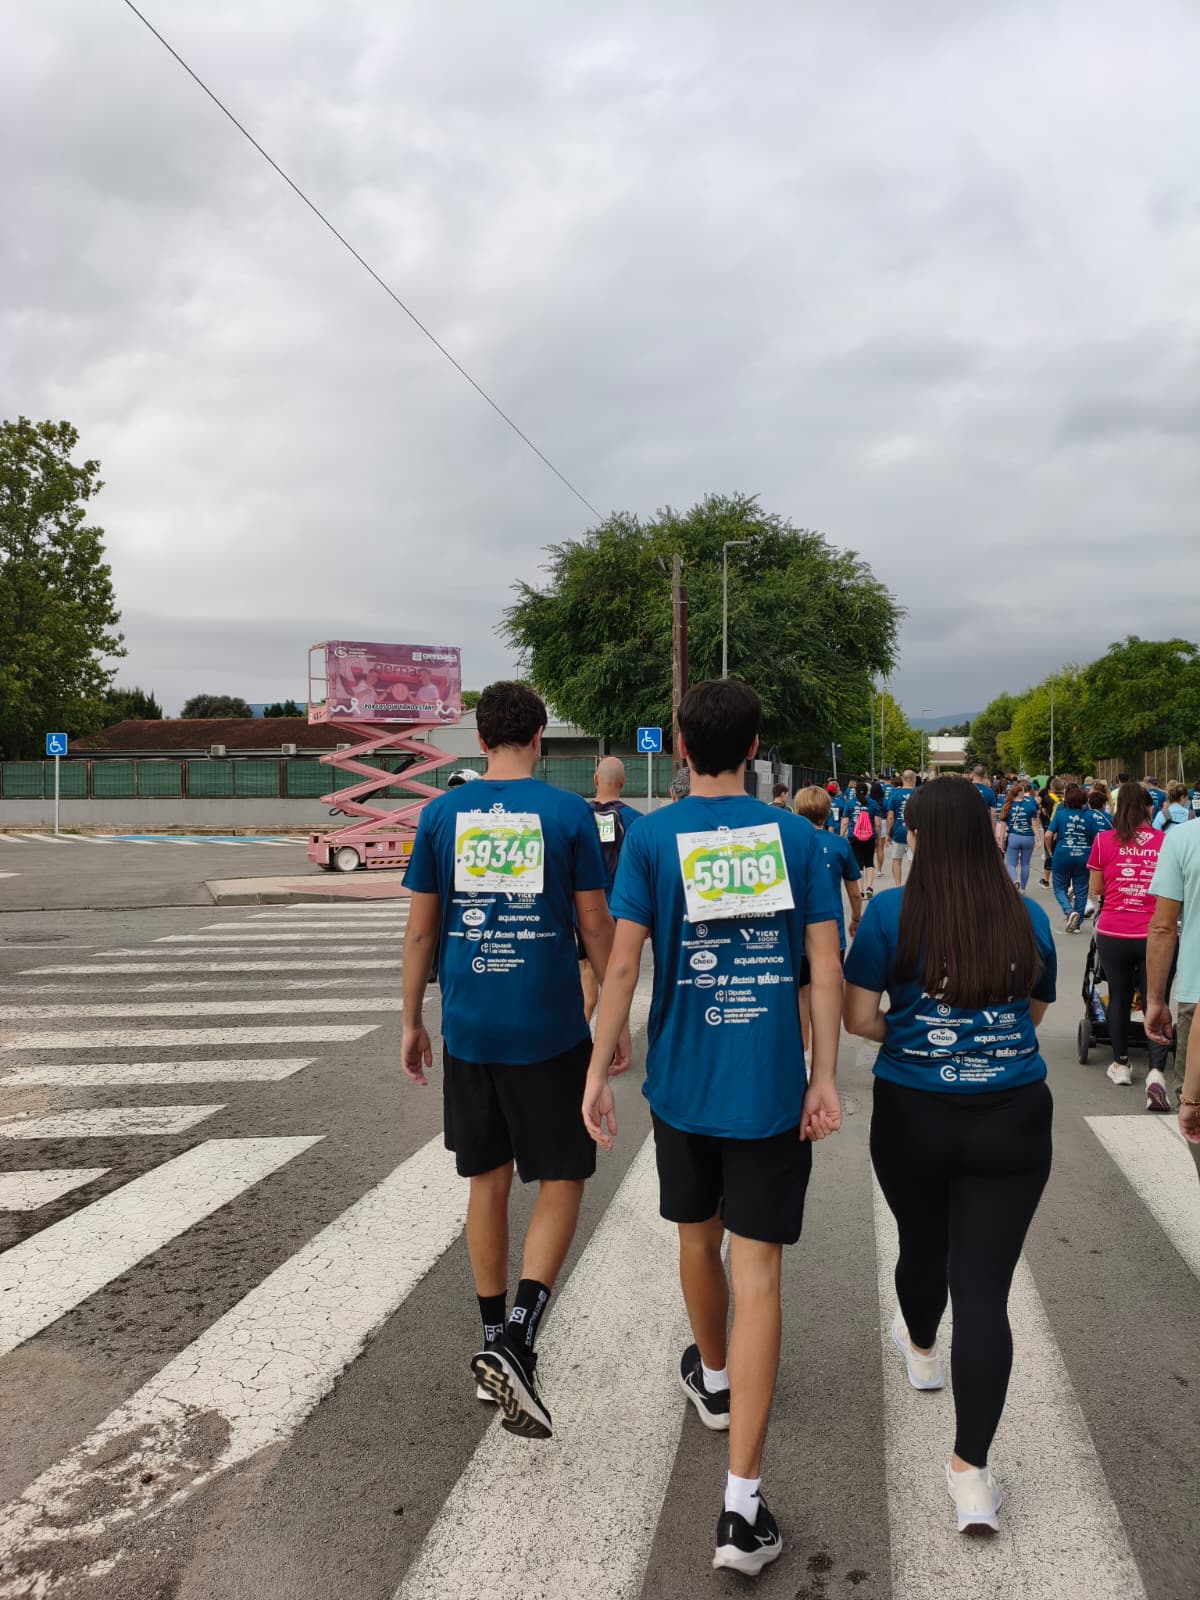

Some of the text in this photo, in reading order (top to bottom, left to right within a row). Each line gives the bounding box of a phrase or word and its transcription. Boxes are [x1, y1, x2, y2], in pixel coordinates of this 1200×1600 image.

[462, 839, 540, 868] 59349
[1119, 846, 1157, 857] sklum
[694, 854, 777, 891] 59169
[498, 915, 540, 923] aquaservice
[734, 955, 784, 966] aquaservice
[974, 1033, 1022, 1044] aquaservice
